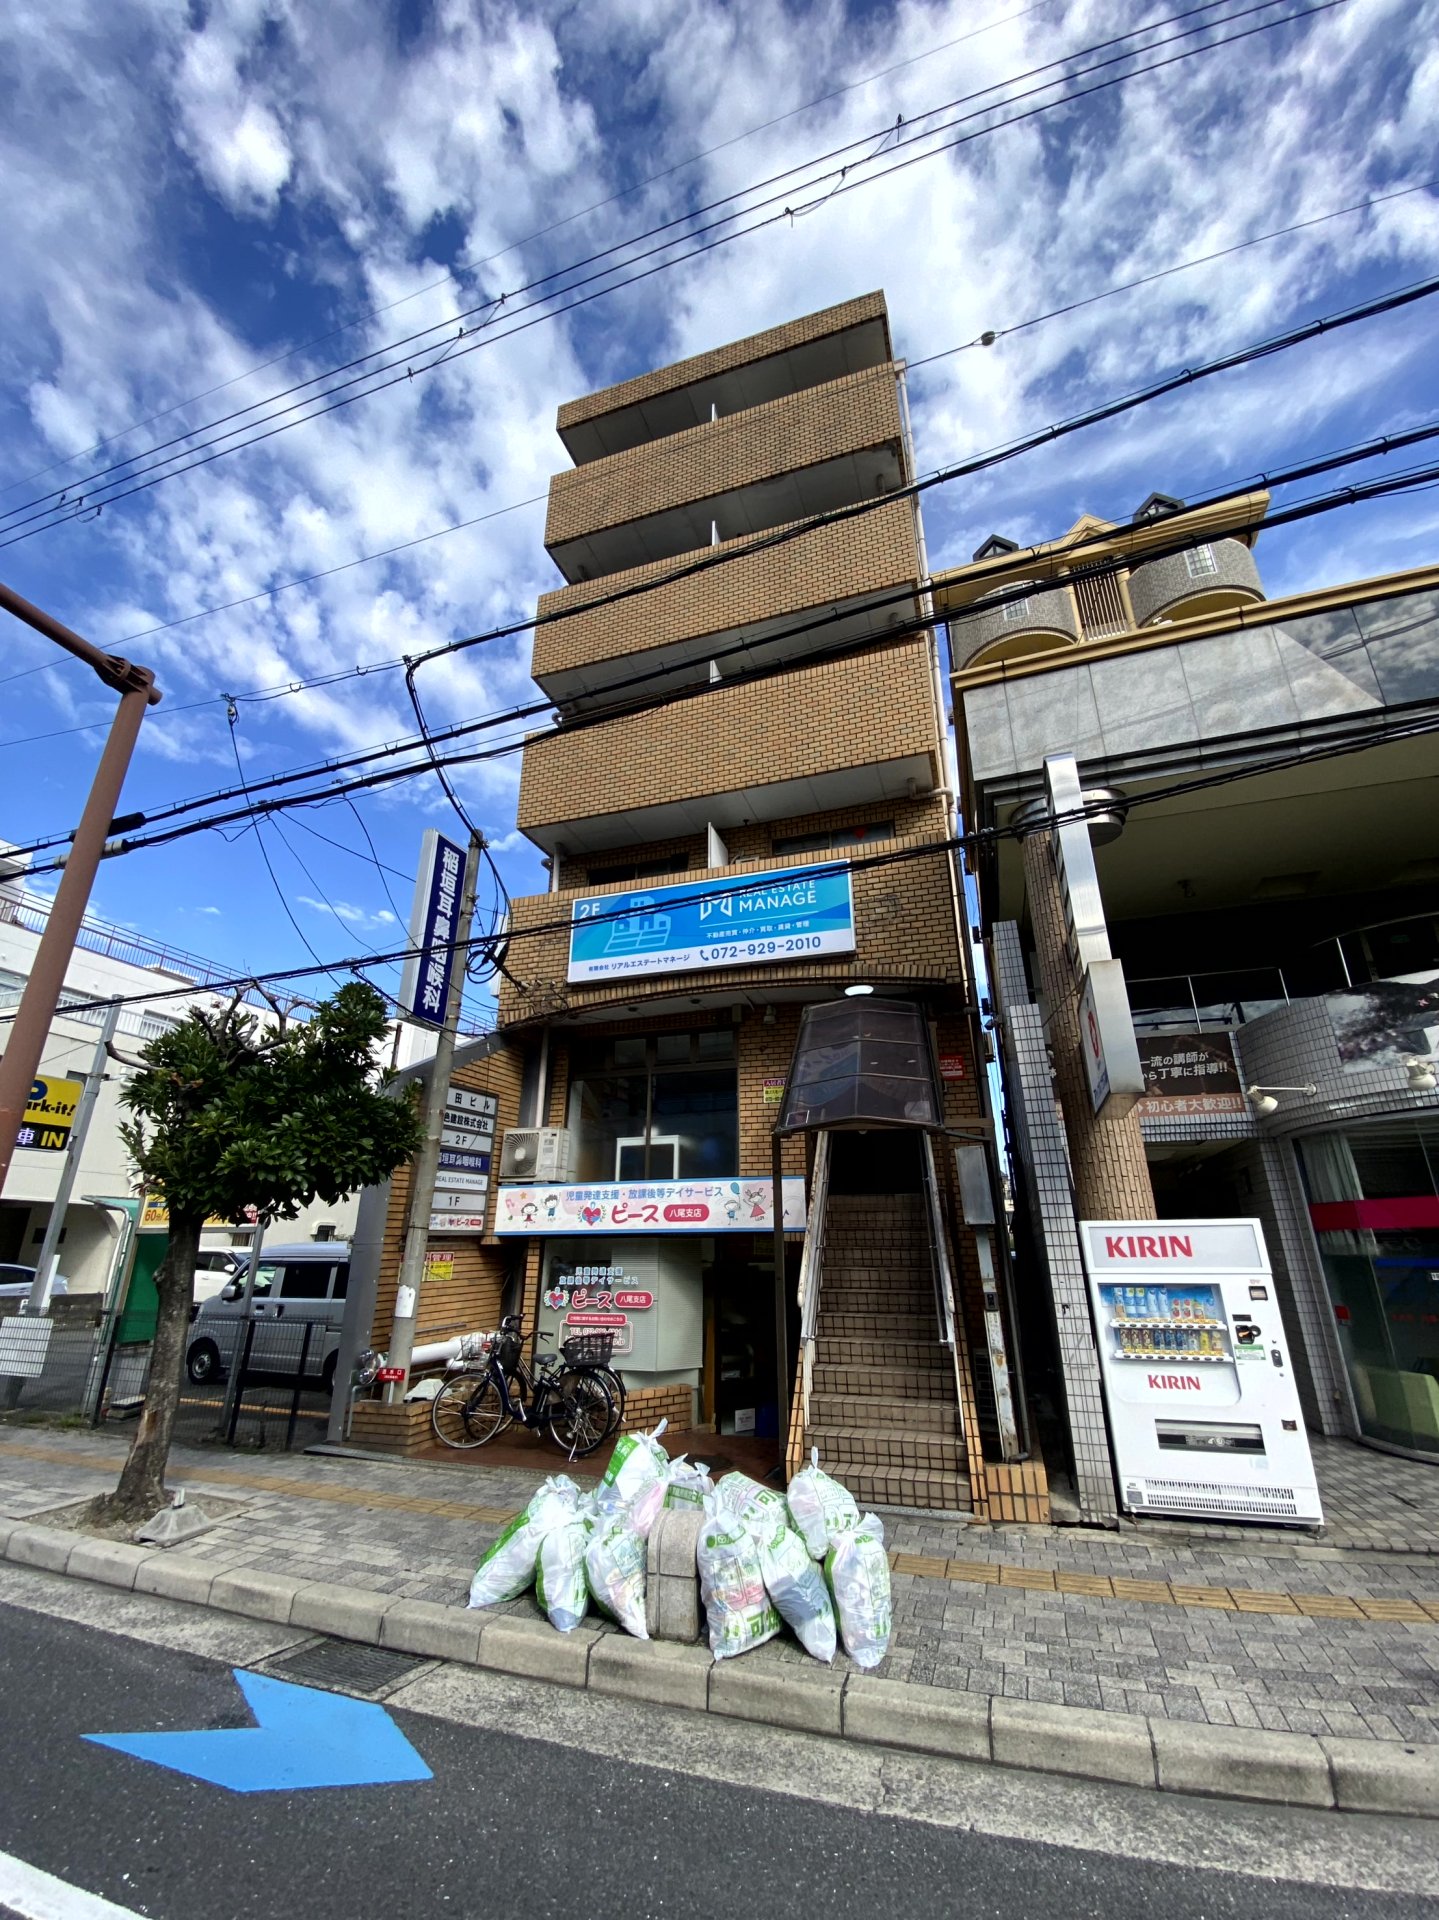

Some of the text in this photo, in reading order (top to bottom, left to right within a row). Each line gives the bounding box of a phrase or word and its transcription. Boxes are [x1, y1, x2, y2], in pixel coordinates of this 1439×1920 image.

[771, 879, 816, 894] ESTATE
[739, 891, 817, 913] MANAGE
[580, 903, 600, 919] 2F
[711, 936, 821, 960] 072-929-2010
[611, 954, 690, 970] リアルエステートマネージ
[40, 1131, 65, 1148] IN
[455, 1134, 467, 1146] 2F
[449, 1196, 460, 1206] 1F
[611, 1204, 702, 1224] ピース 八尾支店
[1105, 1235, 1194, 1259] KIRIN
[572, 1288, 612, 1309] ピース
[1148, 1374, 1201, 1391] KIRIN
